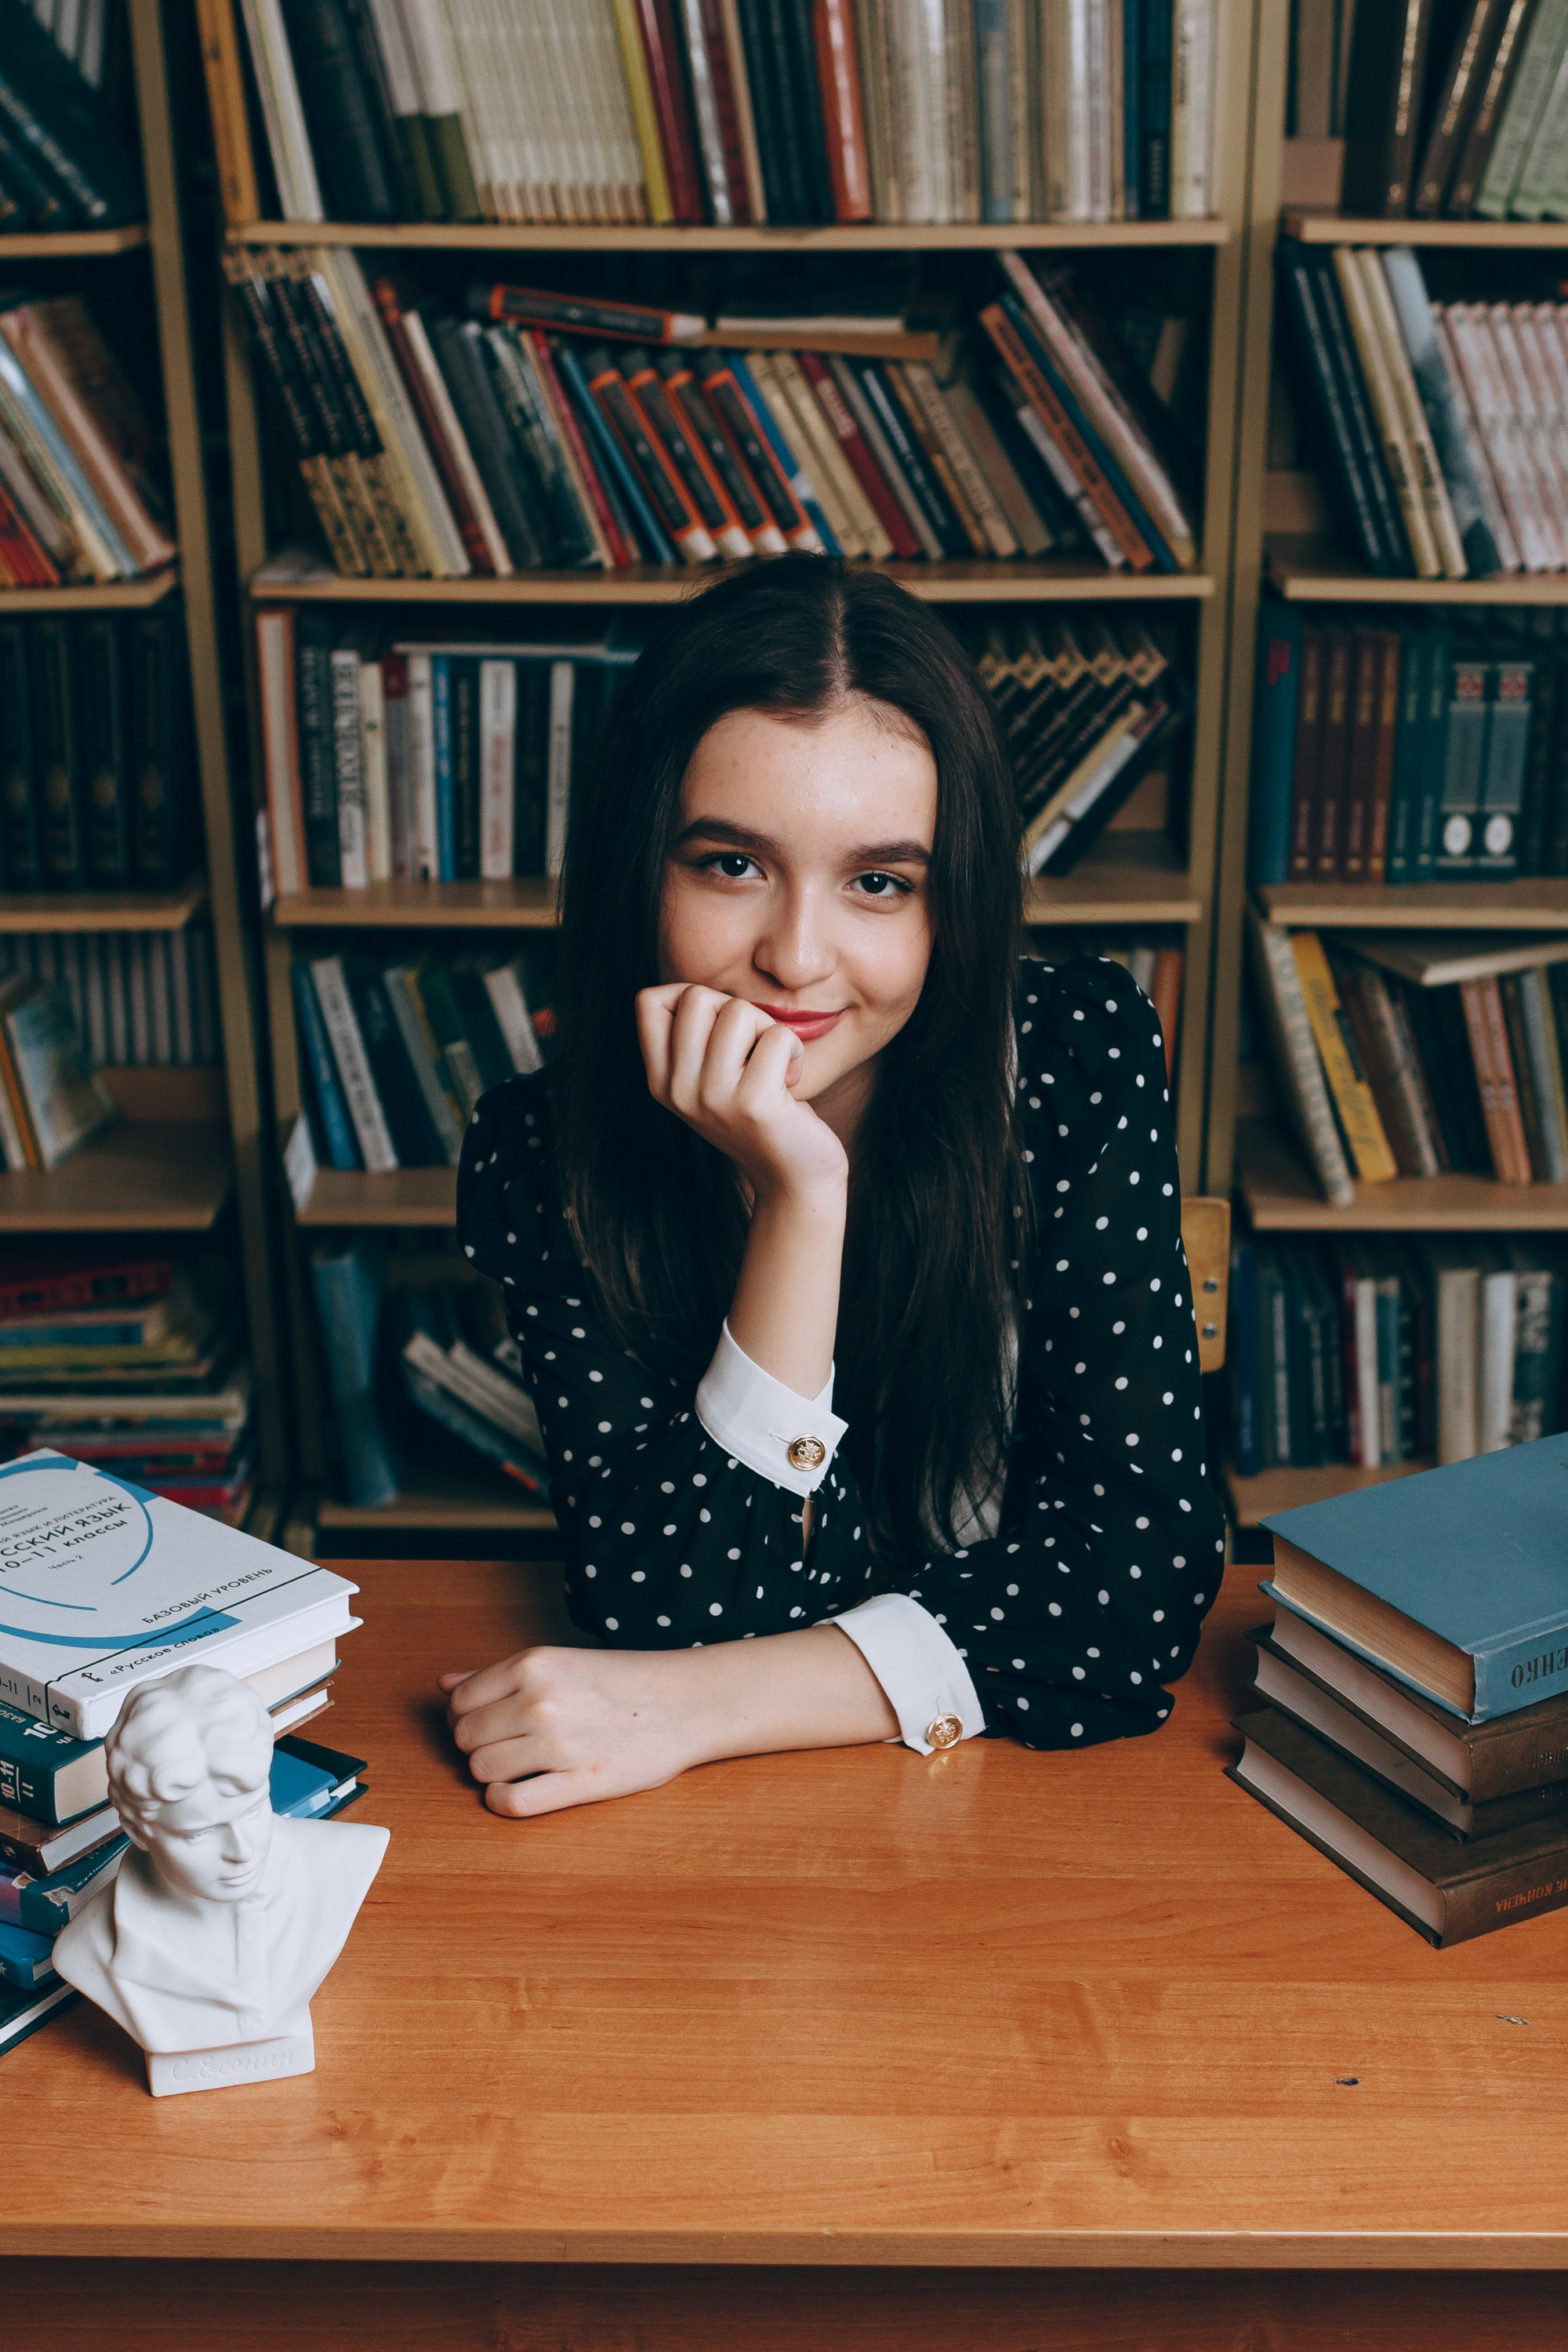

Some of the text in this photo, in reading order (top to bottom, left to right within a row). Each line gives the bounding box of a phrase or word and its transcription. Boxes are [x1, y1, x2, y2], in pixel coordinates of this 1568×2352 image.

[13, 1524, 42, 1539] ЯЗЫК
[54, 1496, 117, 1523] ЛИТЕРАТУРА
[74, 1503, 132, 1527] ЯЗЫК
[63, 1520, 128, 1547] классы
[48, 1558, 75, 1570] Часть
[142, 1568, 273, 1624] БАЗОВЫЙ УРОВЕНЬ
[110, 1627, 220, 1675] «Русское слово»
[1495, 1883, 1553, 1913] КОНЧЕНА
